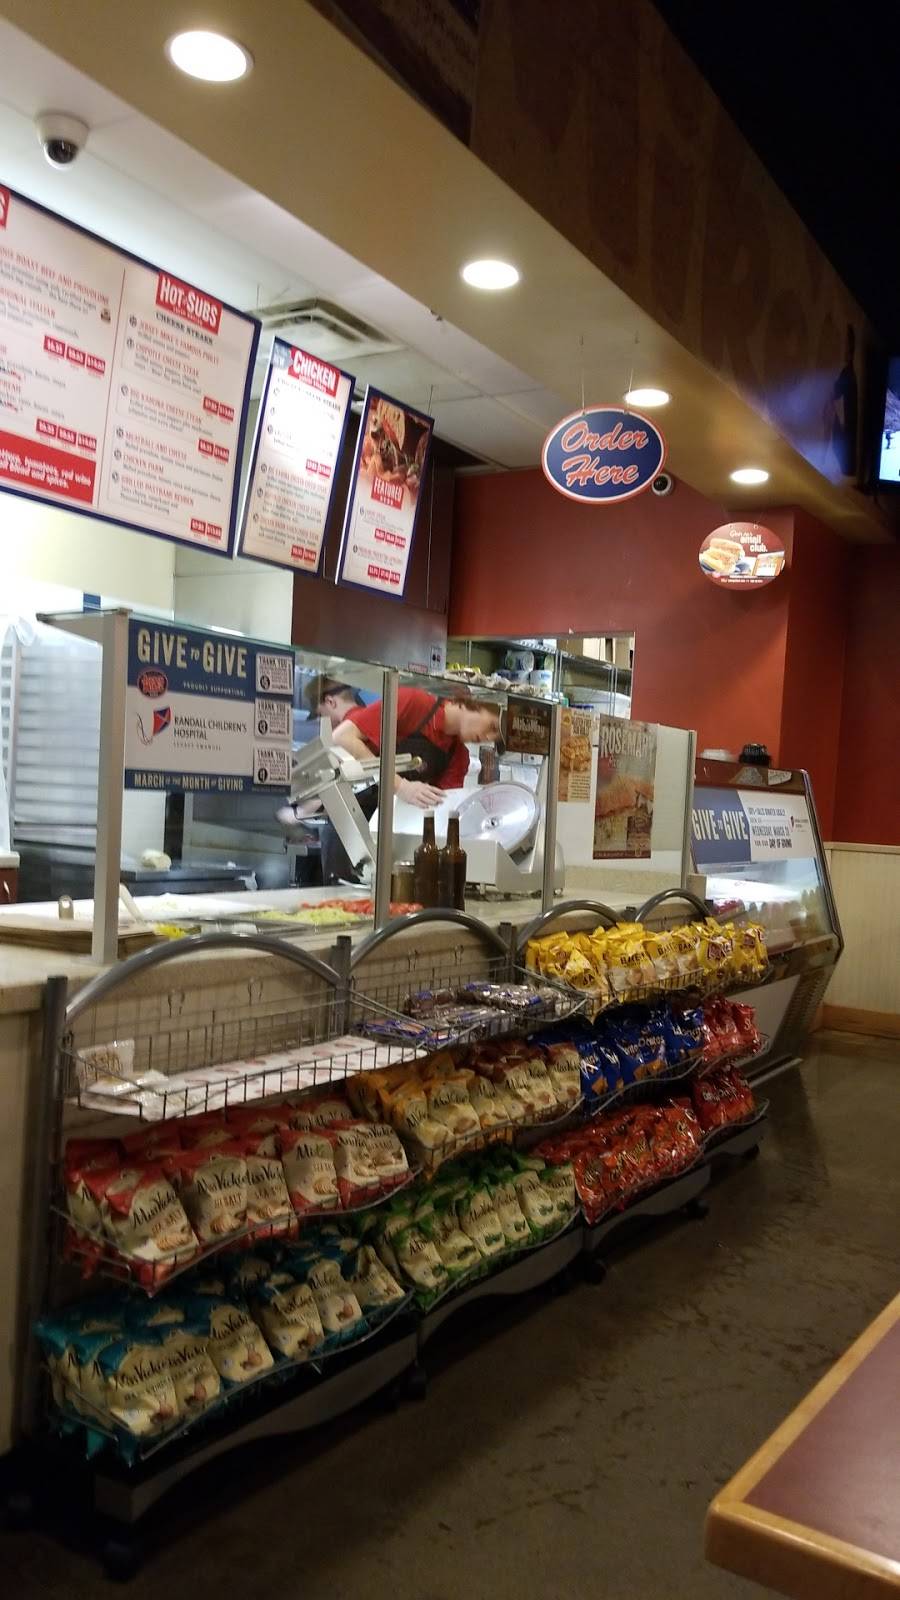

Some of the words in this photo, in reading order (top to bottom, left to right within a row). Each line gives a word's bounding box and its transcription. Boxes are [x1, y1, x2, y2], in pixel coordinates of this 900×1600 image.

[293, 349, 336, 392] CHICKEN
[560, 419, 650, 454] Order
[561, 454, 640, 488] Here
[739, 534, 762, 545] email
[136, 628, 188, 669] GIVE
[190, 647, 200, 661] TO
[202, 639, 248, 679] GIVE
[173, 728, 208, 741] HOSPITAL
[174, 716, 208, 729] RANDALL
[134, 772, 166, 788] MARCH
[182, 774, 211, 790] MONTH
[218, 777, 244, 792] GIVING
[691, 808, 720, 841] GIVE
[722, 809, 750, 841] GIVE
